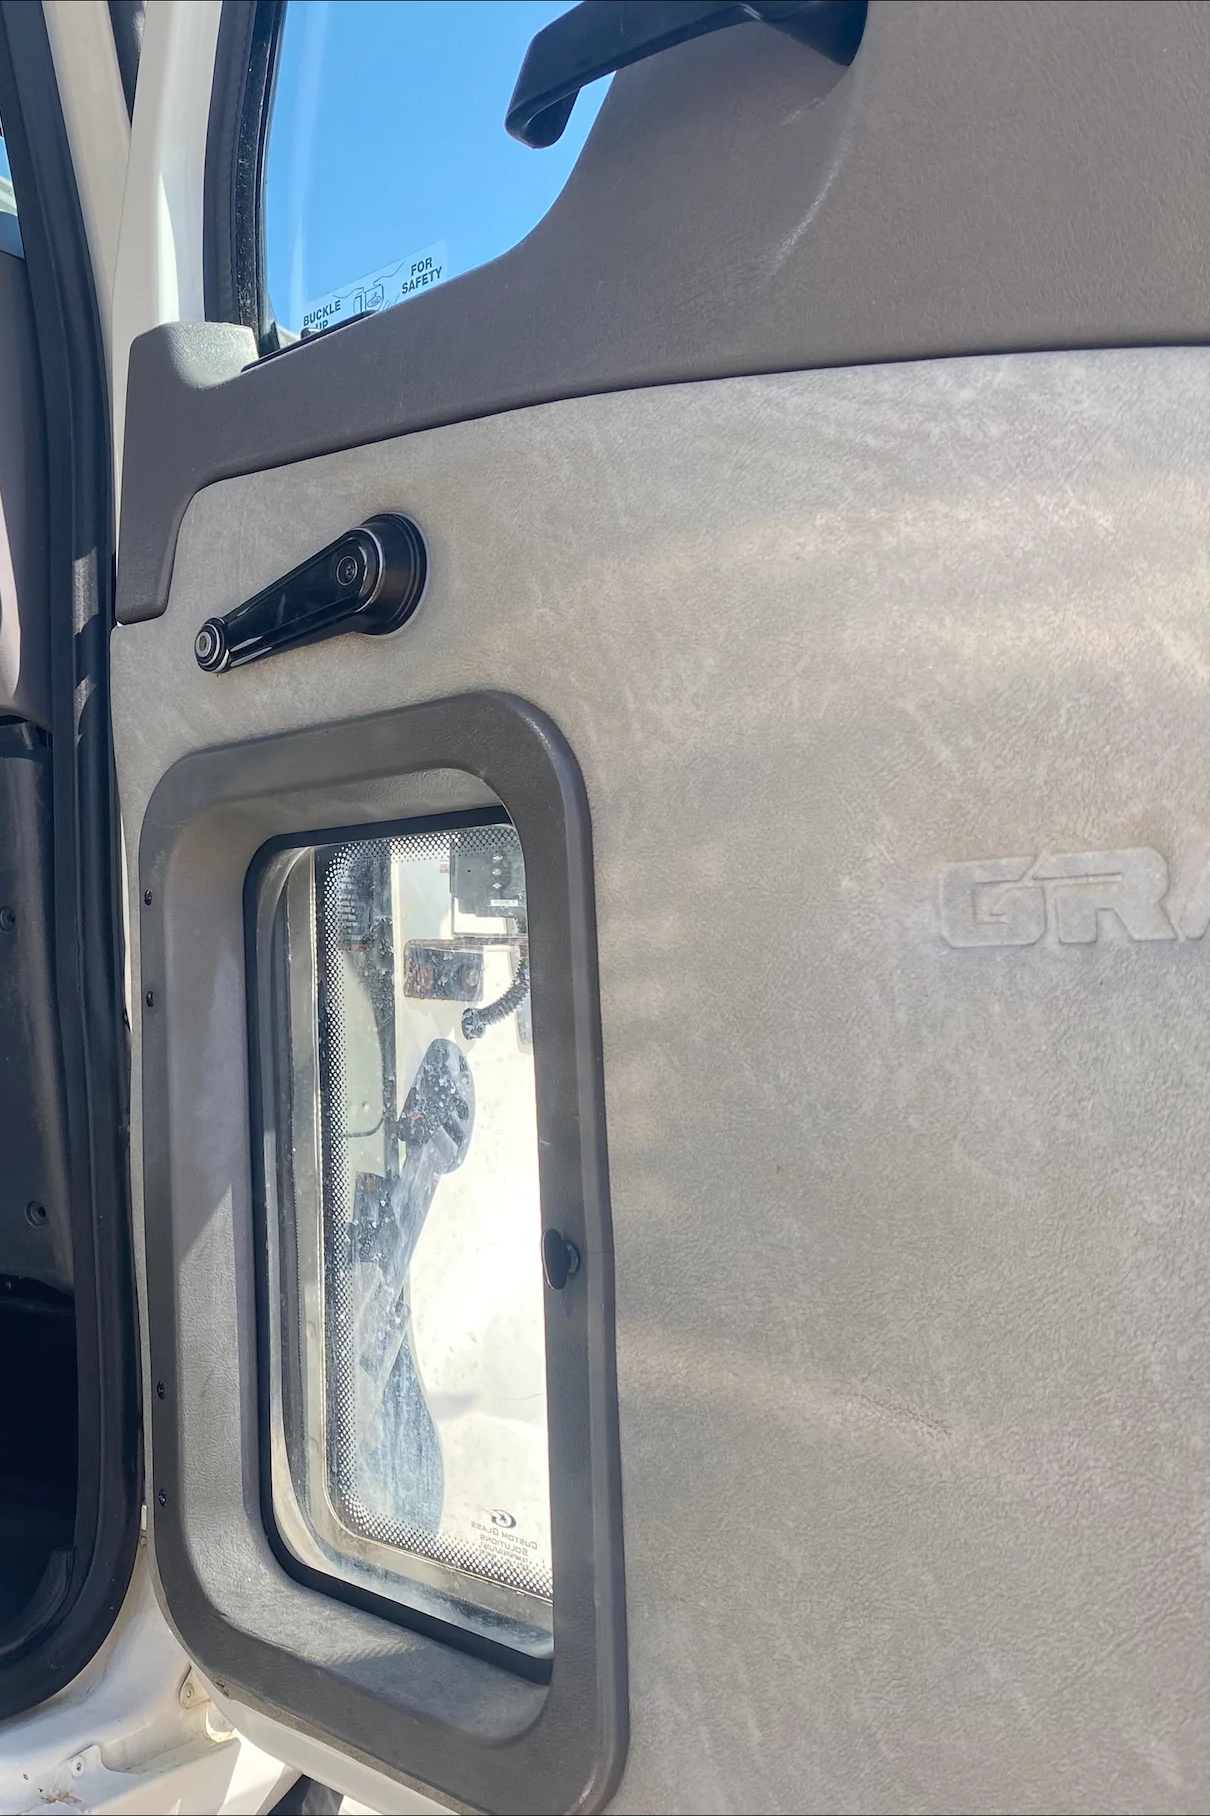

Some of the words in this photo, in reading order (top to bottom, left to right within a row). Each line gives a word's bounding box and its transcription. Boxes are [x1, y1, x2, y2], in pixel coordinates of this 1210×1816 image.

[410, 256, 433, 276] FOR
[401, 266, 443, 295] SAFETY
[303, 300, 341, 327] BUCKLE
[940, 846, 1210, 949] GR
